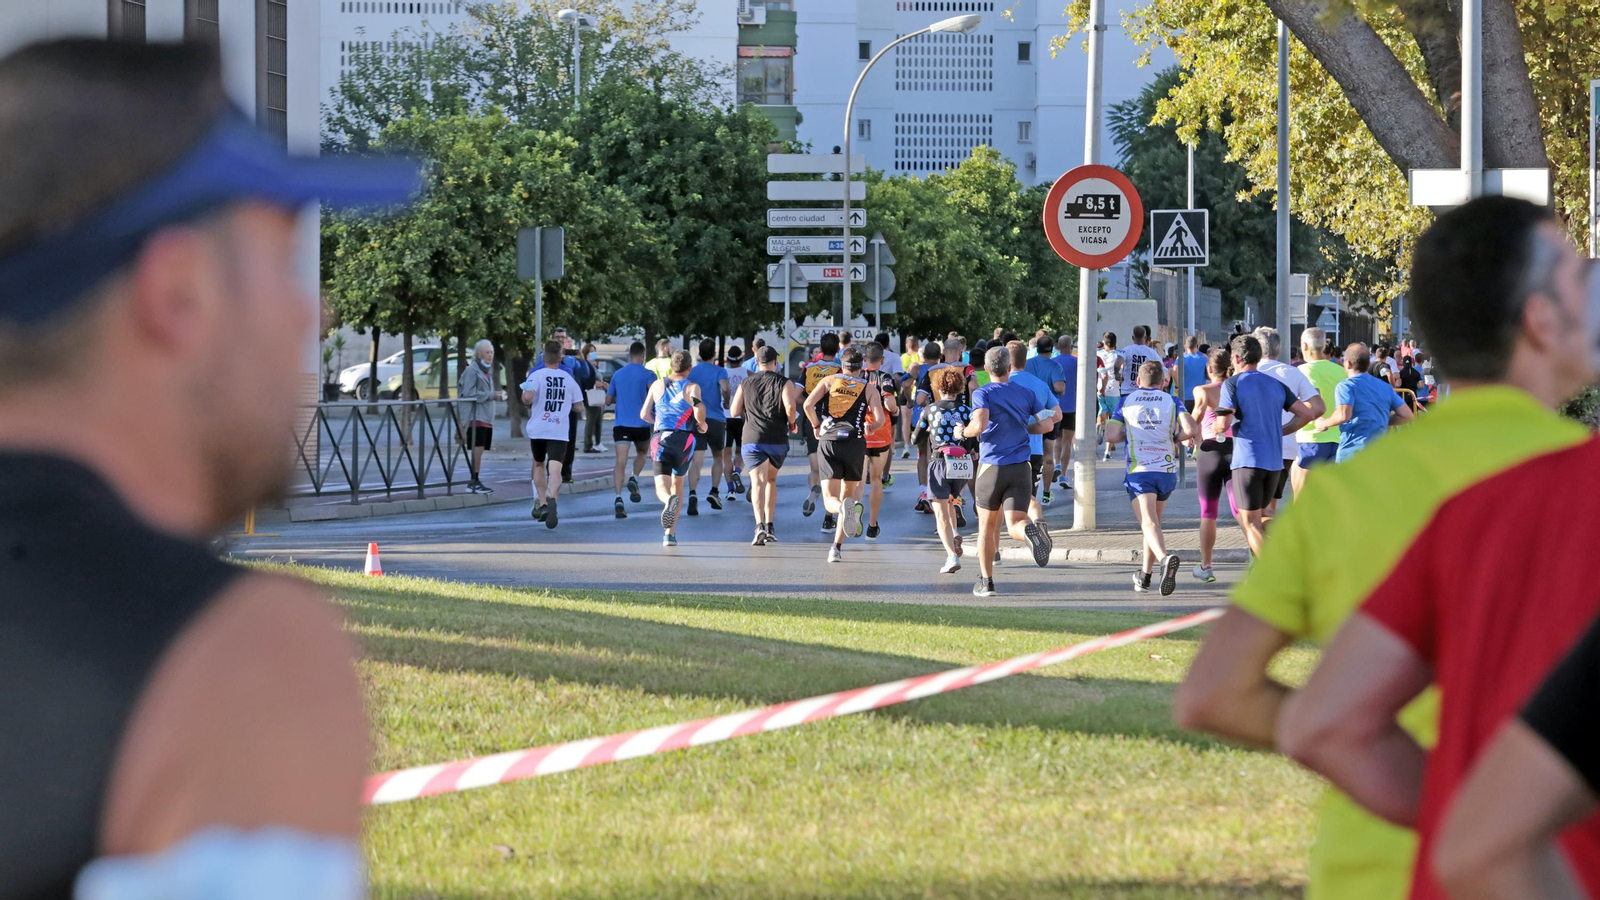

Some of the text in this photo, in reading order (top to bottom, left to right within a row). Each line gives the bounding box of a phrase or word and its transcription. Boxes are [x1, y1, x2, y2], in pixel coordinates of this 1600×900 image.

[1086, 196, 1115, 212] 8,5 t
[1078, 225, 1112, 234] EXCEPTO
[1080, 236, 1108, 244] VICASA
[546, 376, 566, 388] SAT.
[546, 388, 565, 400] RUN
[544, 400, 564, 412] OUT
[952, 462, 969, 471] 926
